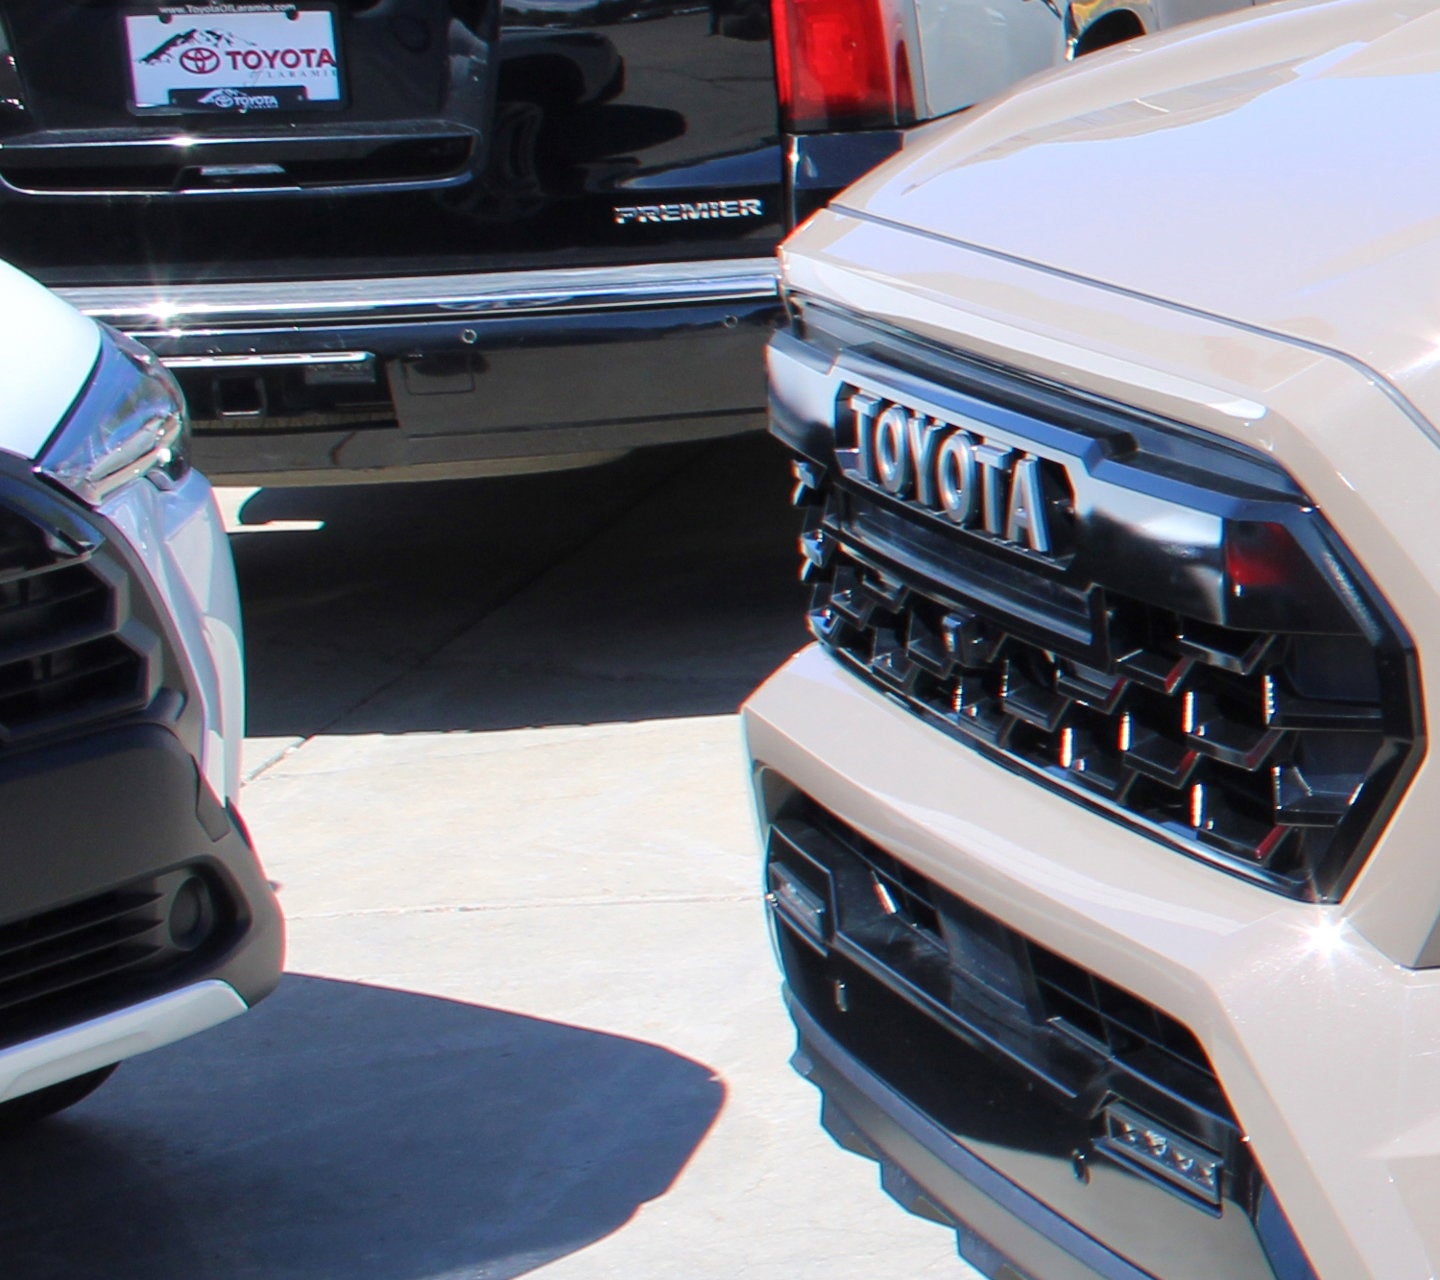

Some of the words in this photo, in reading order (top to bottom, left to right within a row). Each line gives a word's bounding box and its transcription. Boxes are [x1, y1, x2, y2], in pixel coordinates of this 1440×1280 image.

[225, 48, 336, 69] TOYOTA
[613, 198, 764, 224] PREMIER
[849, 392, 1049, 553] TOYOTA
